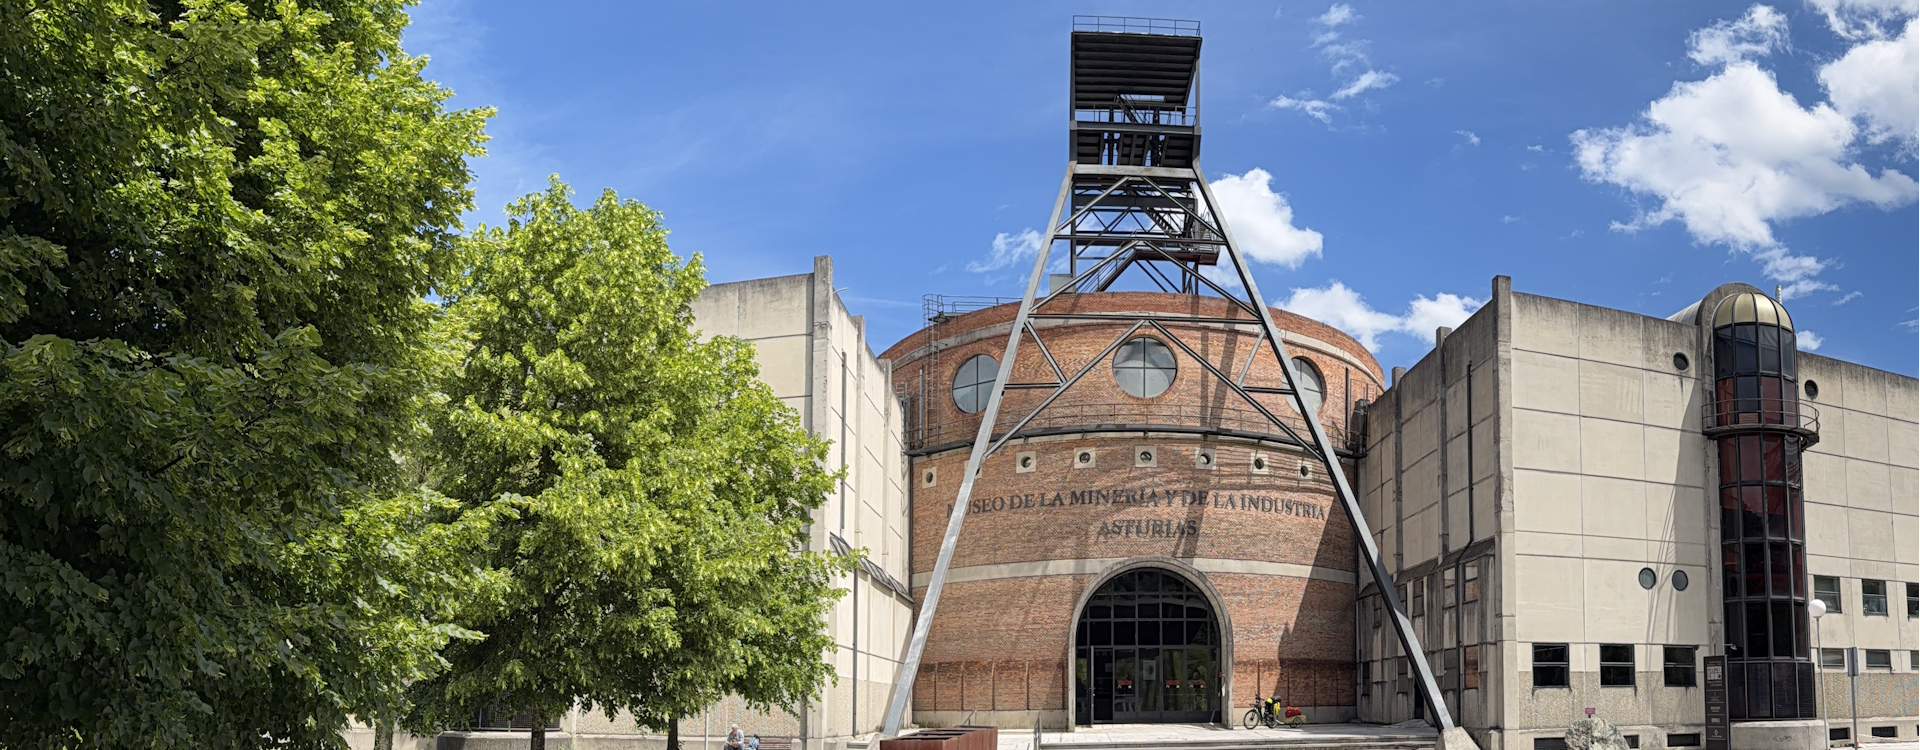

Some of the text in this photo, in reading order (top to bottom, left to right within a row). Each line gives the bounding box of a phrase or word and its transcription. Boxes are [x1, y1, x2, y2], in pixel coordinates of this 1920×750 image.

[1009, 494, 1035, 510] DE
[1040, 492, 1064, 507] LA
[1165, 489, 1177, 507] Y
[1182, 489, 1209, 508] DE
[1213, 491, 1237, 509] LA
[1240, 493, 1325, 520] INDUSTRIA
[1097, 520, 1197, 537] ASTURIAS
